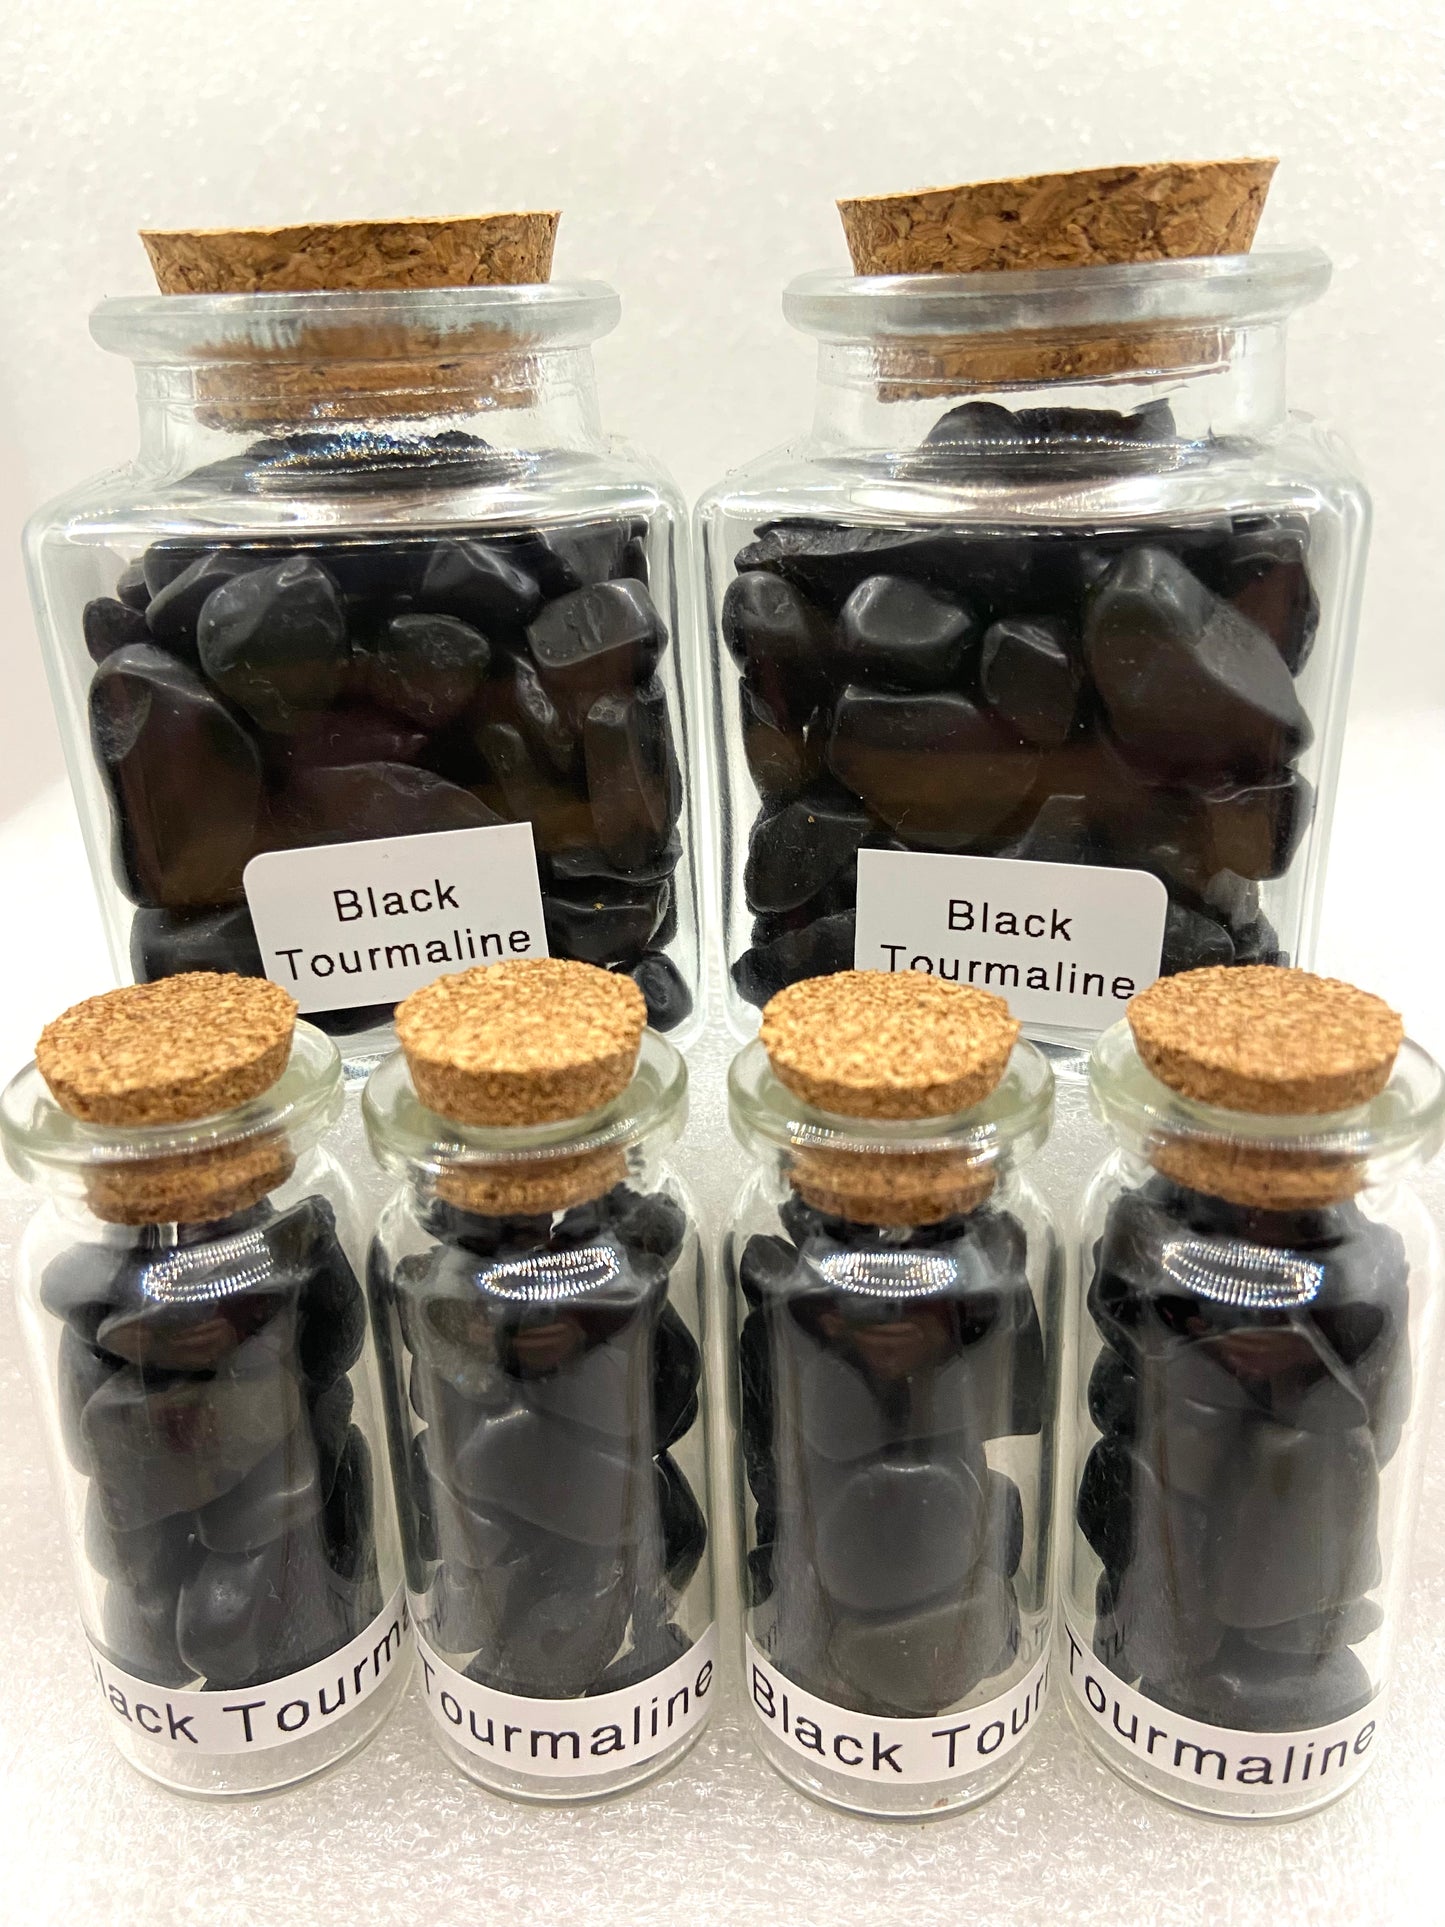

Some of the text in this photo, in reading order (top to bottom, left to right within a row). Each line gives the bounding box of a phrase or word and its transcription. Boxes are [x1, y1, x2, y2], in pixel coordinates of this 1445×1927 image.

[333, 878, 460, 922] Black
[948, 899, 1073, 941] Black
[275, 928, 532, 981] Tourmaline
[880, 944, 1136, 1000] Tourmaline
[416, 1645, 714, 1760] Tourmaline
[752, 1663, 904, 1773] Black
[1064, 1622, 1377, 1785] Tourmaline
